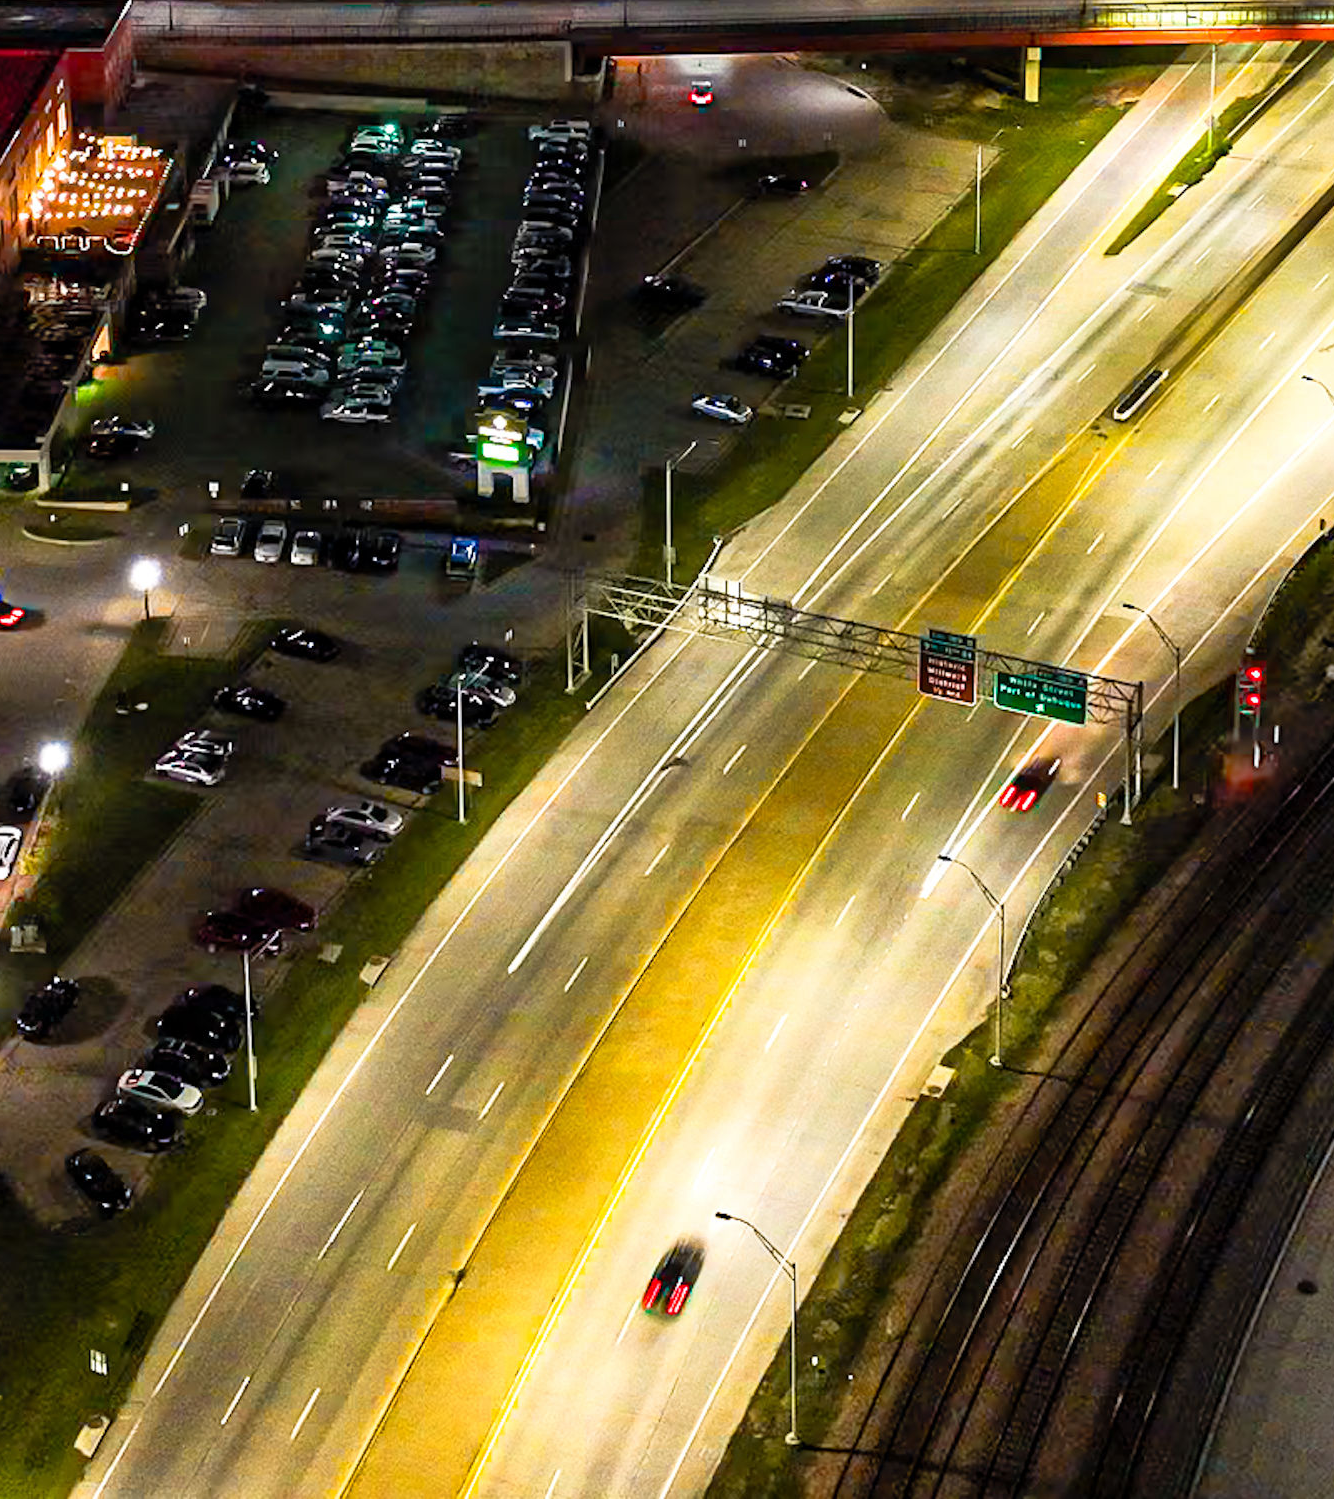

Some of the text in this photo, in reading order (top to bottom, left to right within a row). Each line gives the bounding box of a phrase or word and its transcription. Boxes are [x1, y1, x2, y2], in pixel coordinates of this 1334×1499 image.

[927, 656, 966, 672] Historic
[926, 665, 967, 682] Millwork
[927, 675, 966, 691] District
[999, 682, 1021, 696] Port
[1039, 692, 1083, 710] Dubuque
